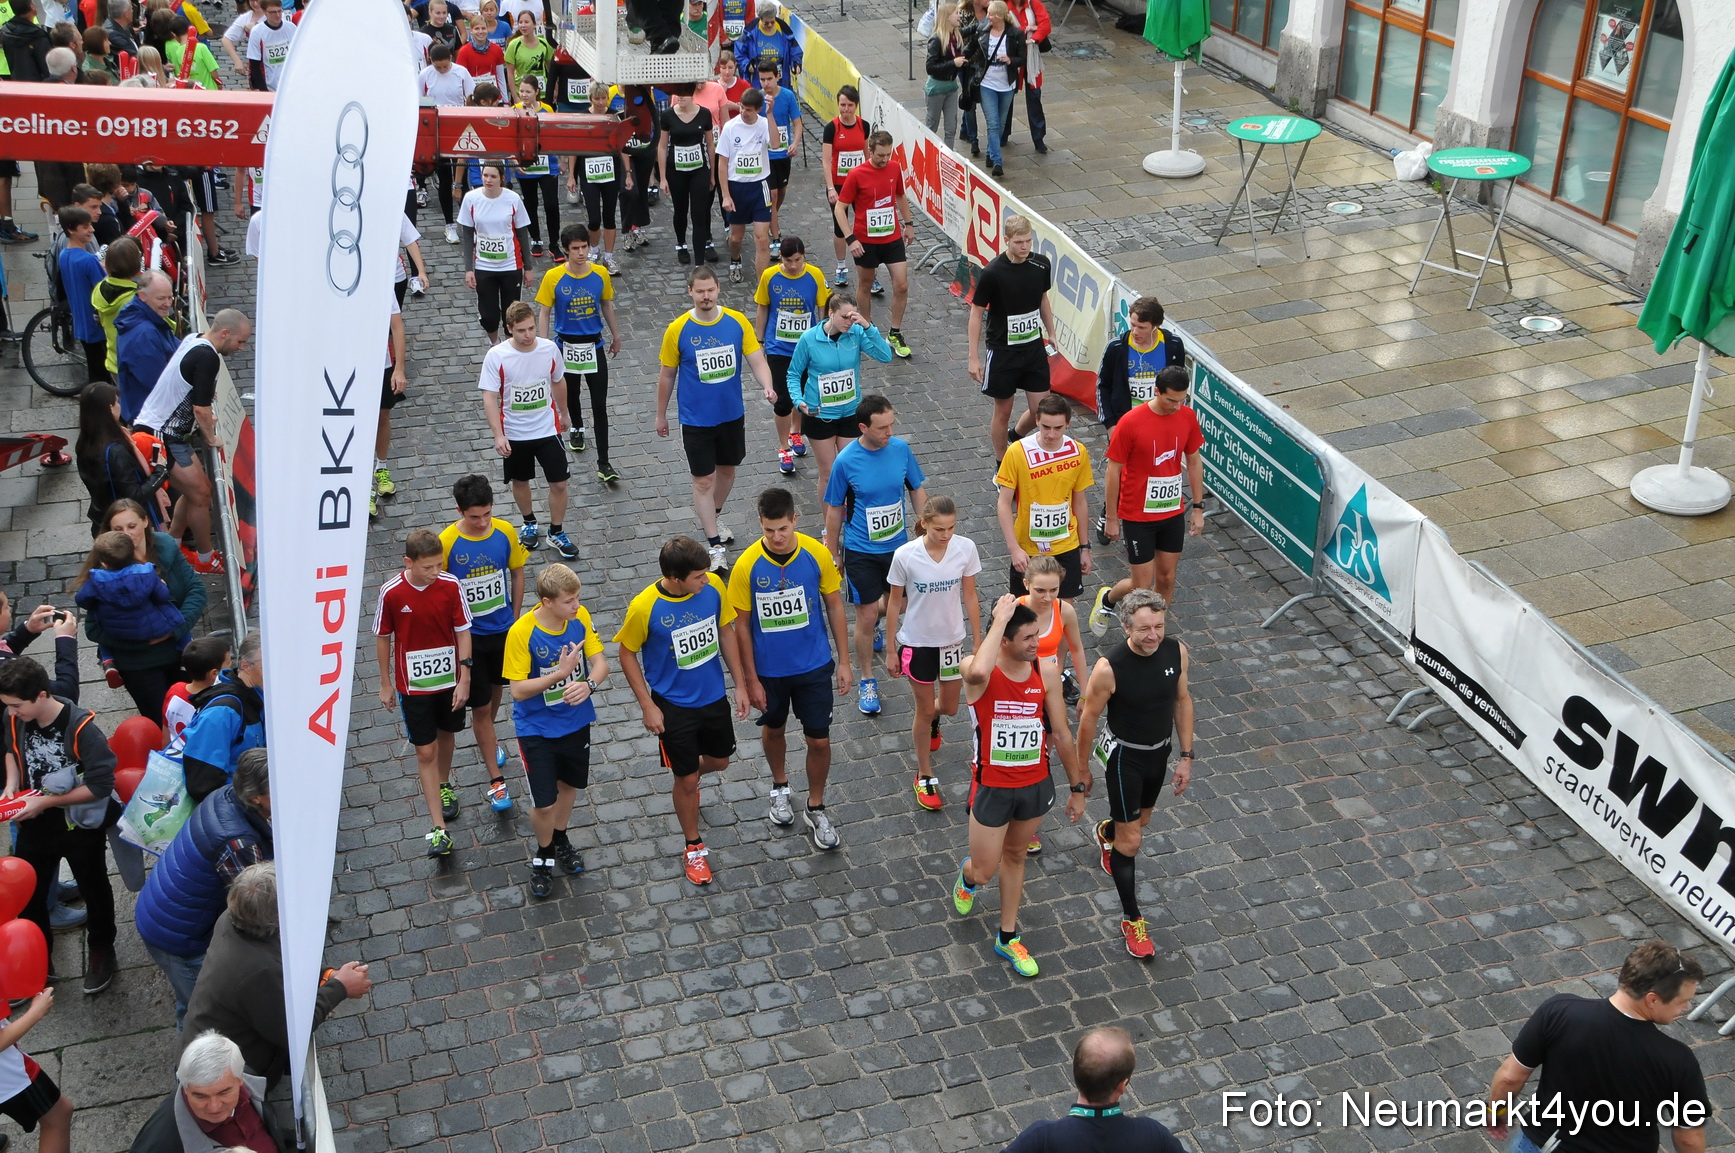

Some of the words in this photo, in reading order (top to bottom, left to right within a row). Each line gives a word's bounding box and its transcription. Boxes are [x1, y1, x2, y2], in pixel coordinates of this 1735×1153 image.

[96, 116, 168, 138] 09181
[176, 118, 240, 139] 6352
[678, 151, 700, 163] 5108
[737, 157, 760, 168] 5021
[841, 157, 863, 167] 5011
[588, 163, 612, 174] 5076
[870, 214, 893, 227] 5172
[480, 240, 505, 252] 5225
[779, 319, 807, 331] 5160
[1011, 317, 1038, 334] 5045
[567, 349, 593, 362] 5555
[701, 353, 733, 372] 5060
[709, 371, 729, 380] Michael
[823, 377, 853, 395] 5079
[514, 387, 545, 403] 5220
[1214, 390, 1273, 445] Event-Leit-Systeme
[318, 366, 356, 531] BKK
[1196, 408, 1221, 441] Mehr
[1223, 431, 1274, 487] Sicherheit
[1030, 467, 1053, 480] MAX
[1056, 459, 1081, 473] BÖGL
[1210, 443, 1225, 466] Ihr
[1226, 457, 1259, 497] Event!
[1150, 483, 1179, 499] 5085
[1034, 511, 1066, 528] 5155
[1213, 477, 1234, 502] Service
[1235, 496, 1250, 516] Line:
[1250, 510, 1269, 534] 09181
[1270, 528, 1287, 549] 6352
[466, 580, 501, 603] 5518
[773, 592, 797, 600] Neumarkt
[929, 585, 953, 594] POINT
[762, 597, 803, 617] 5094
[689, 622, 710, 633] Neumarkt
[774, 618, 796, 626] Tobias
[678, 627, 714, 655] 5093
[308, 564, 349, 746] Audi
[424, 651, 447, 659] Neumarkt
[690, 649, 710, 663] Florian
[412, 656, 452, 678] 5523
[994, 700, 1038, 715] ESB
[1458, 681, 1474, 700] die
[1474, 694, 1518, 739] verbinden
[996, 730, 1039, 749] 5179
[1005, 752, 1029, 761] Florian
[1543, 754, 1667, 874] stadtwerke
